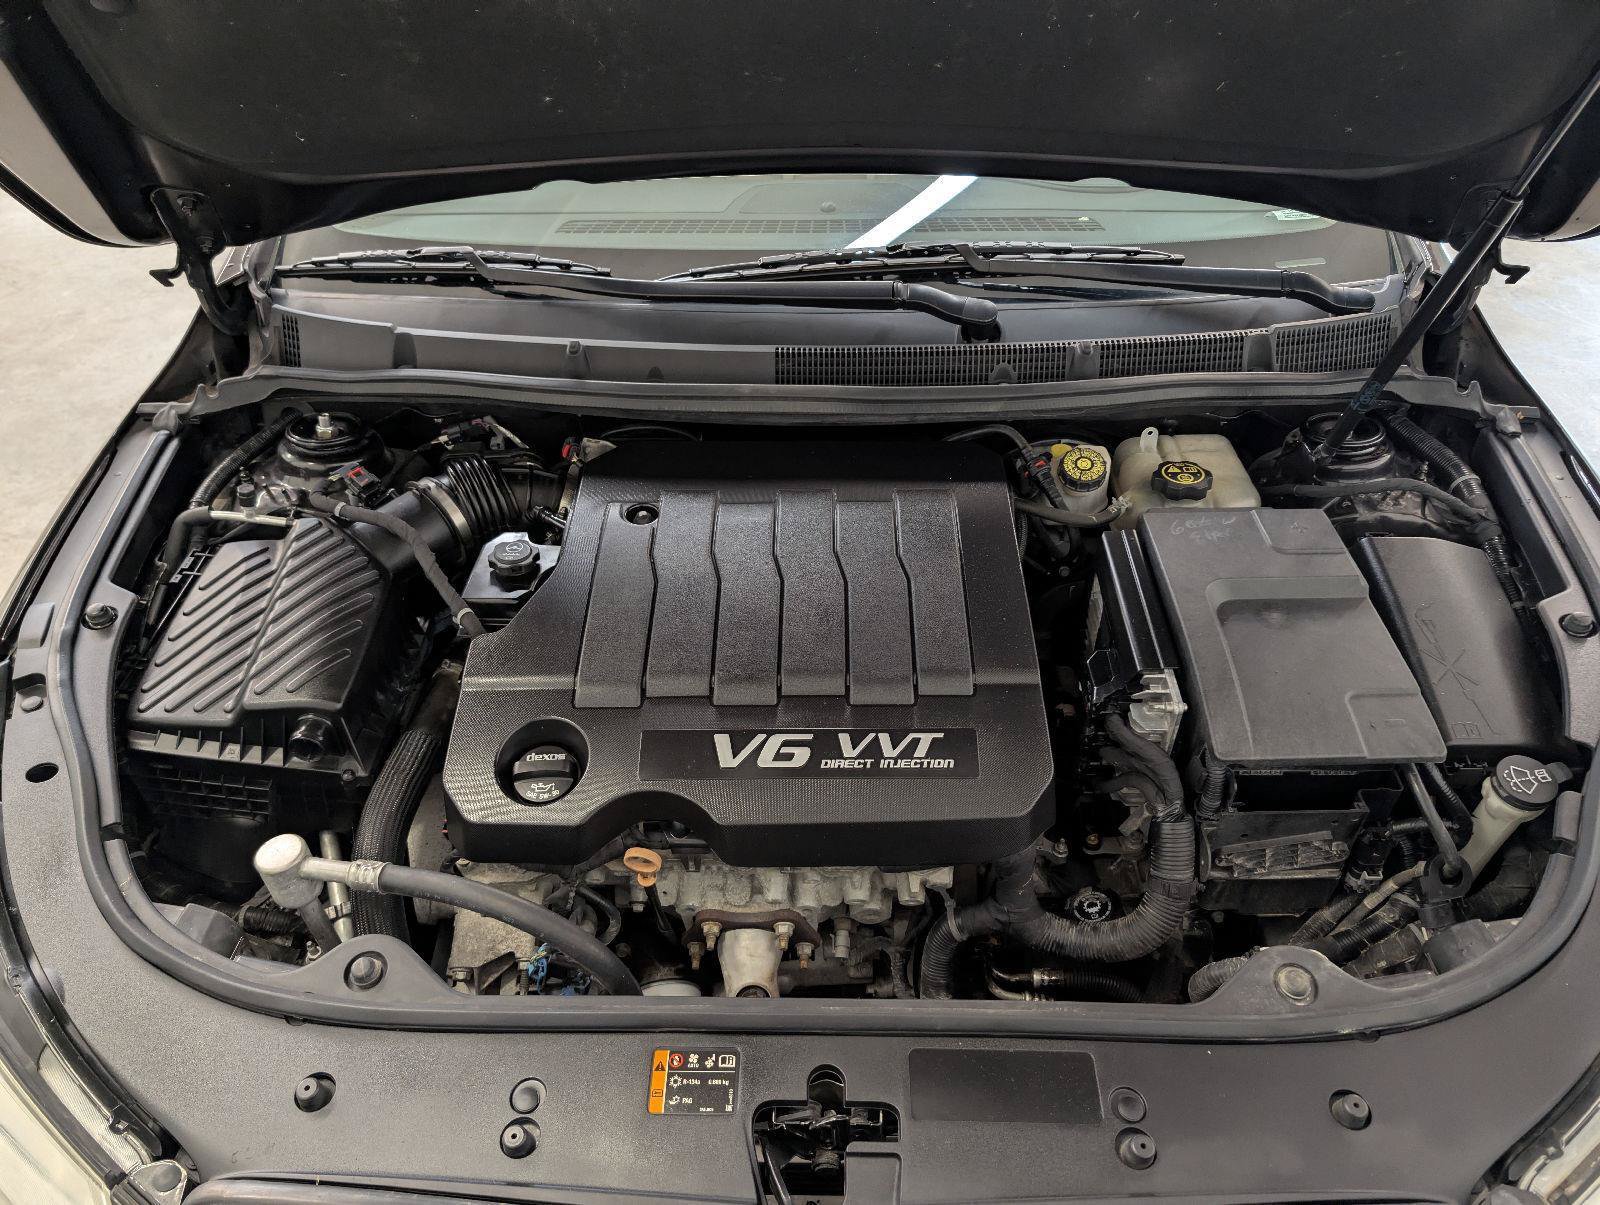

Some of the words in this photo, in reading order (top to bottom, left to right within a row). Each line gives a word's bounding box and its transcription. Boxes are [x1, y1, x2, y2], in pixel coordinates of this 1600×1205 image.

[713, 733, 814, 769] V6
[837, 732, 945, 758] VVT
[526, 752, 567, 762] dexos
[820, 758, 875, 769] DIRECT
[879, 758, 955, 769] INJECTION
